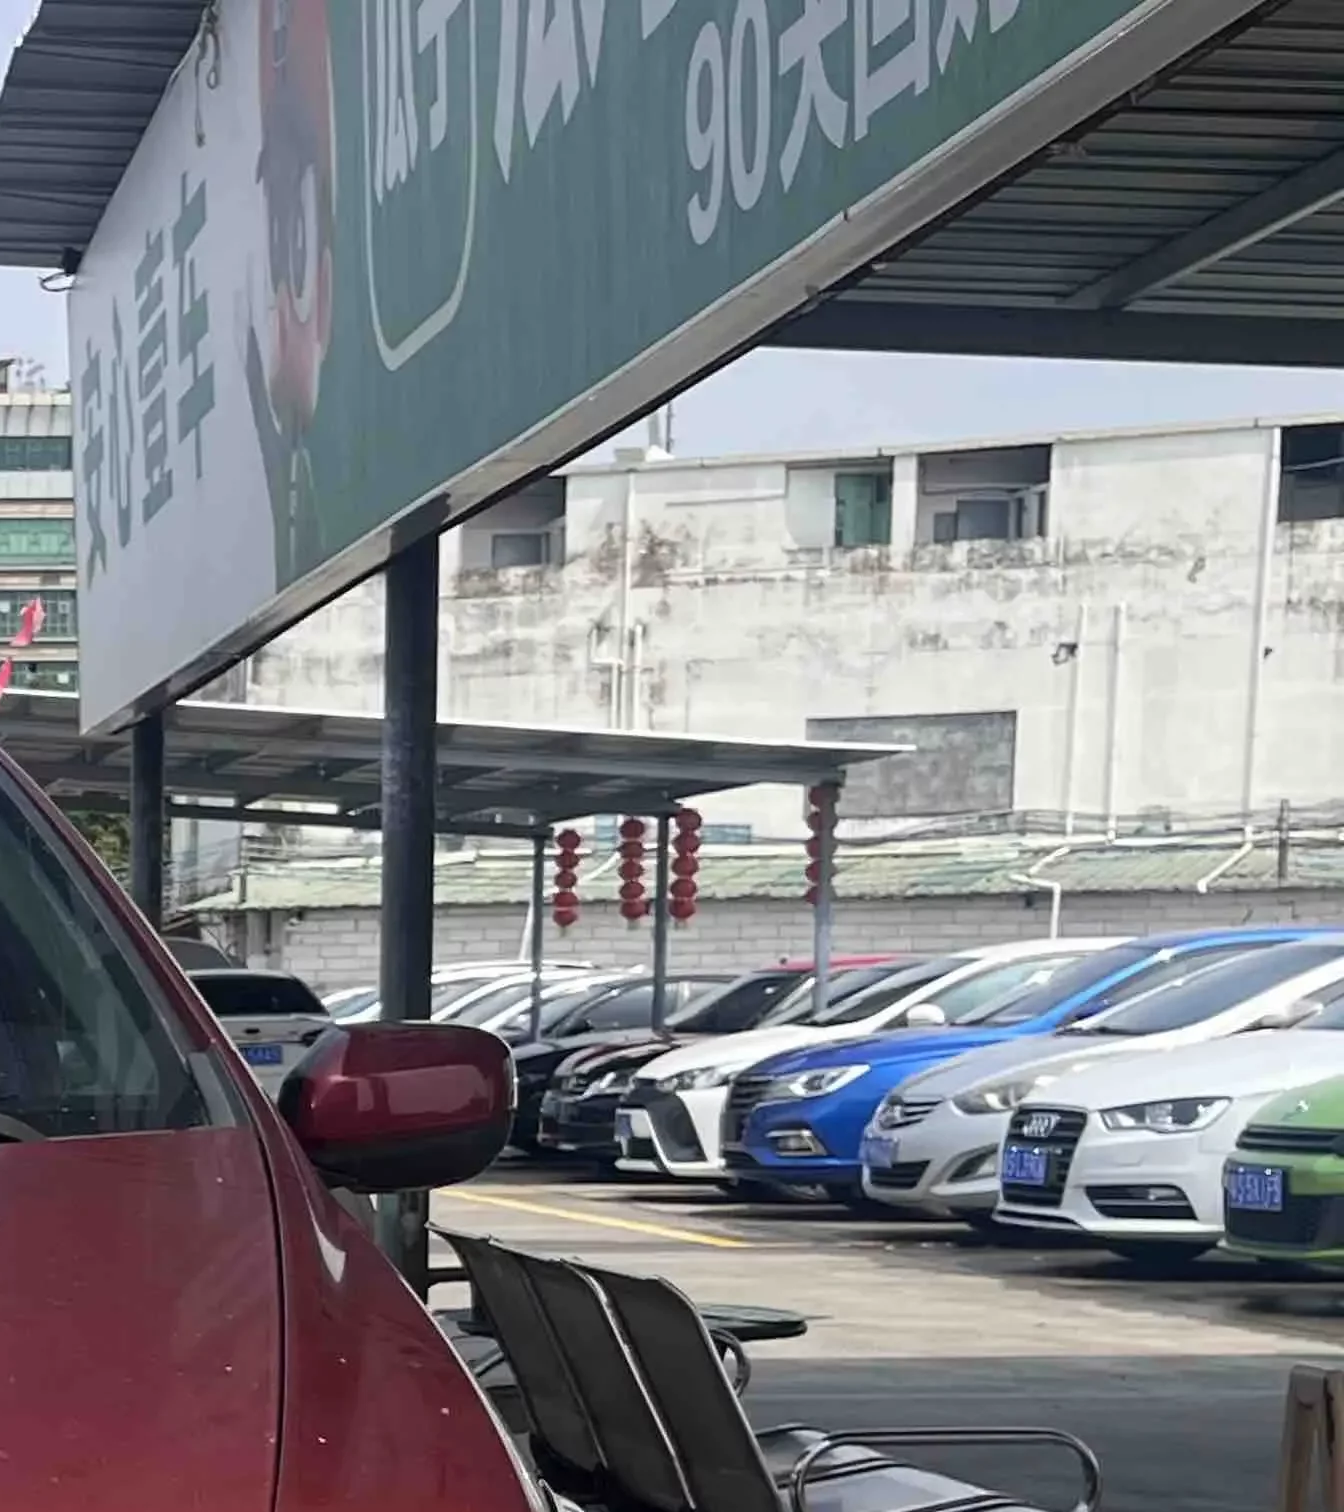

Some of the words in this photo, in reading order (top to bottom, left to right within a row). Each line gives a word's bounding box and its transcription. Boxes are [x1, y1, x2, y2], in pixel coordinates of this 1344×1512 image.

[685, 0, 1017, 246] 90天回
[80, 171, 215, 590] 安心壹车
